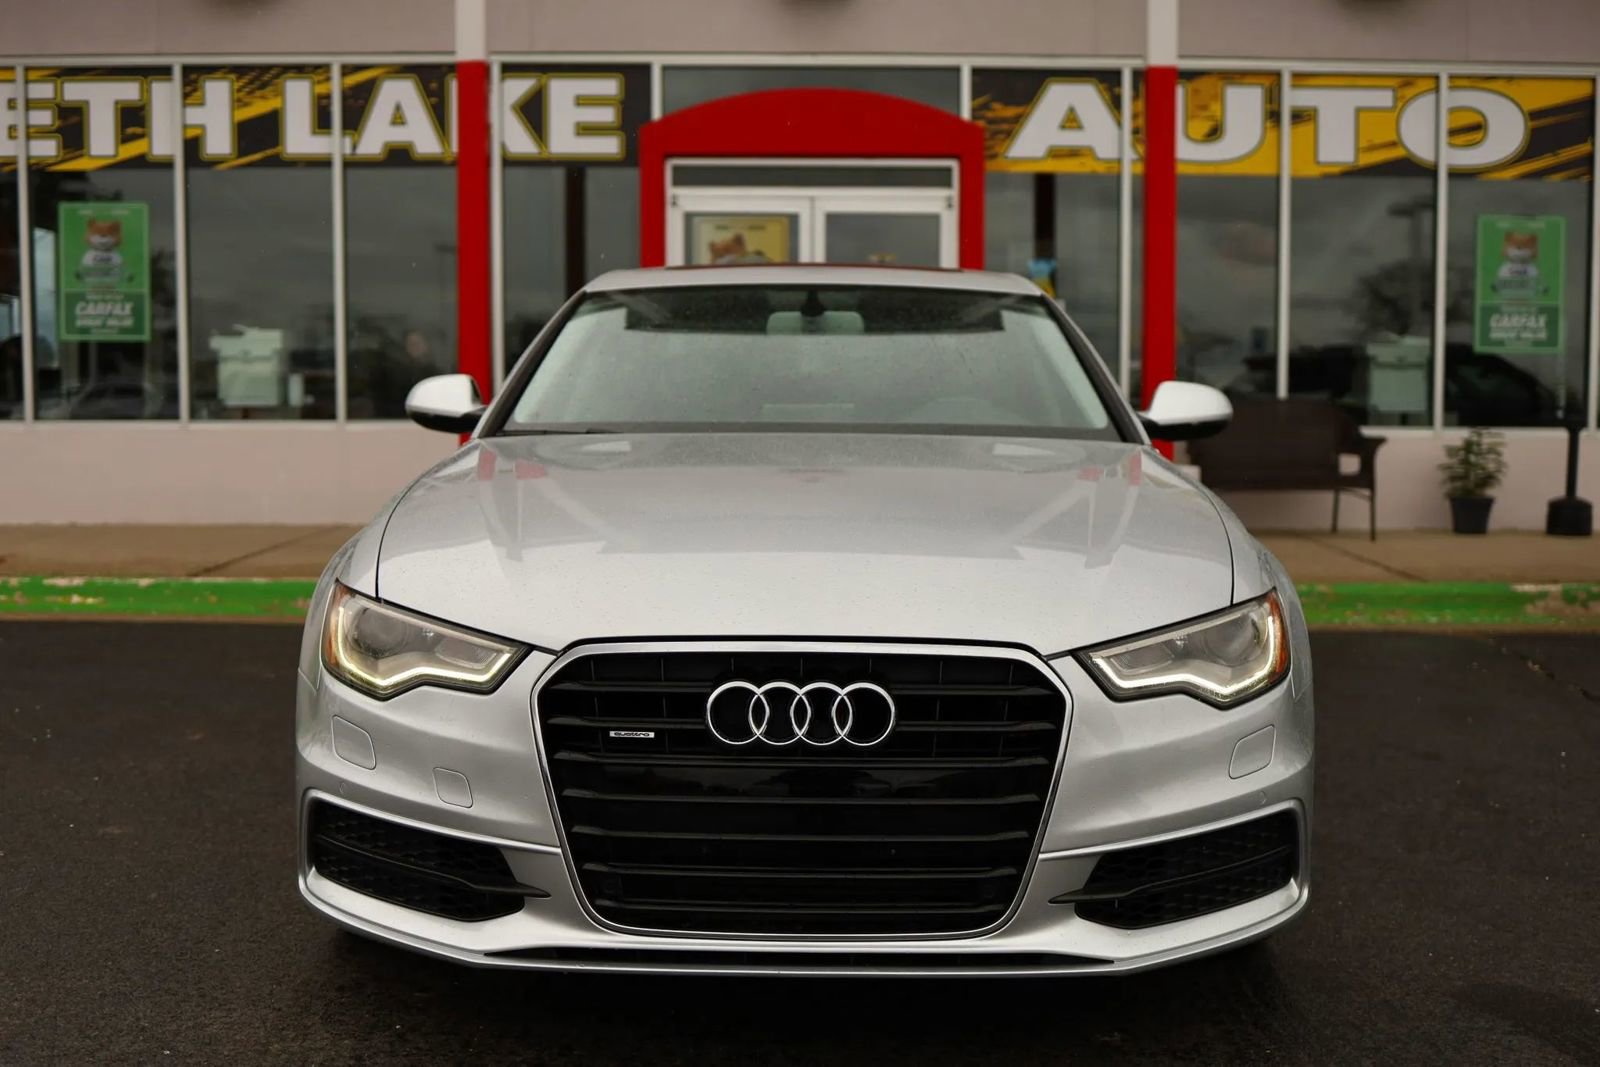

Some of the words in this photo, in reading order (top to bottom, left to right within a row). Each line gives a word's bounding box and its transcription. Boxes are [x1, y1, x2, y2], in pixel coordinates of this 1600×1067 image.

[1002, 77, 1531, 172] AUTO
[75, 301, 134, 316] CARFAX
[1488, 313, 1548, 328] CARFAX
